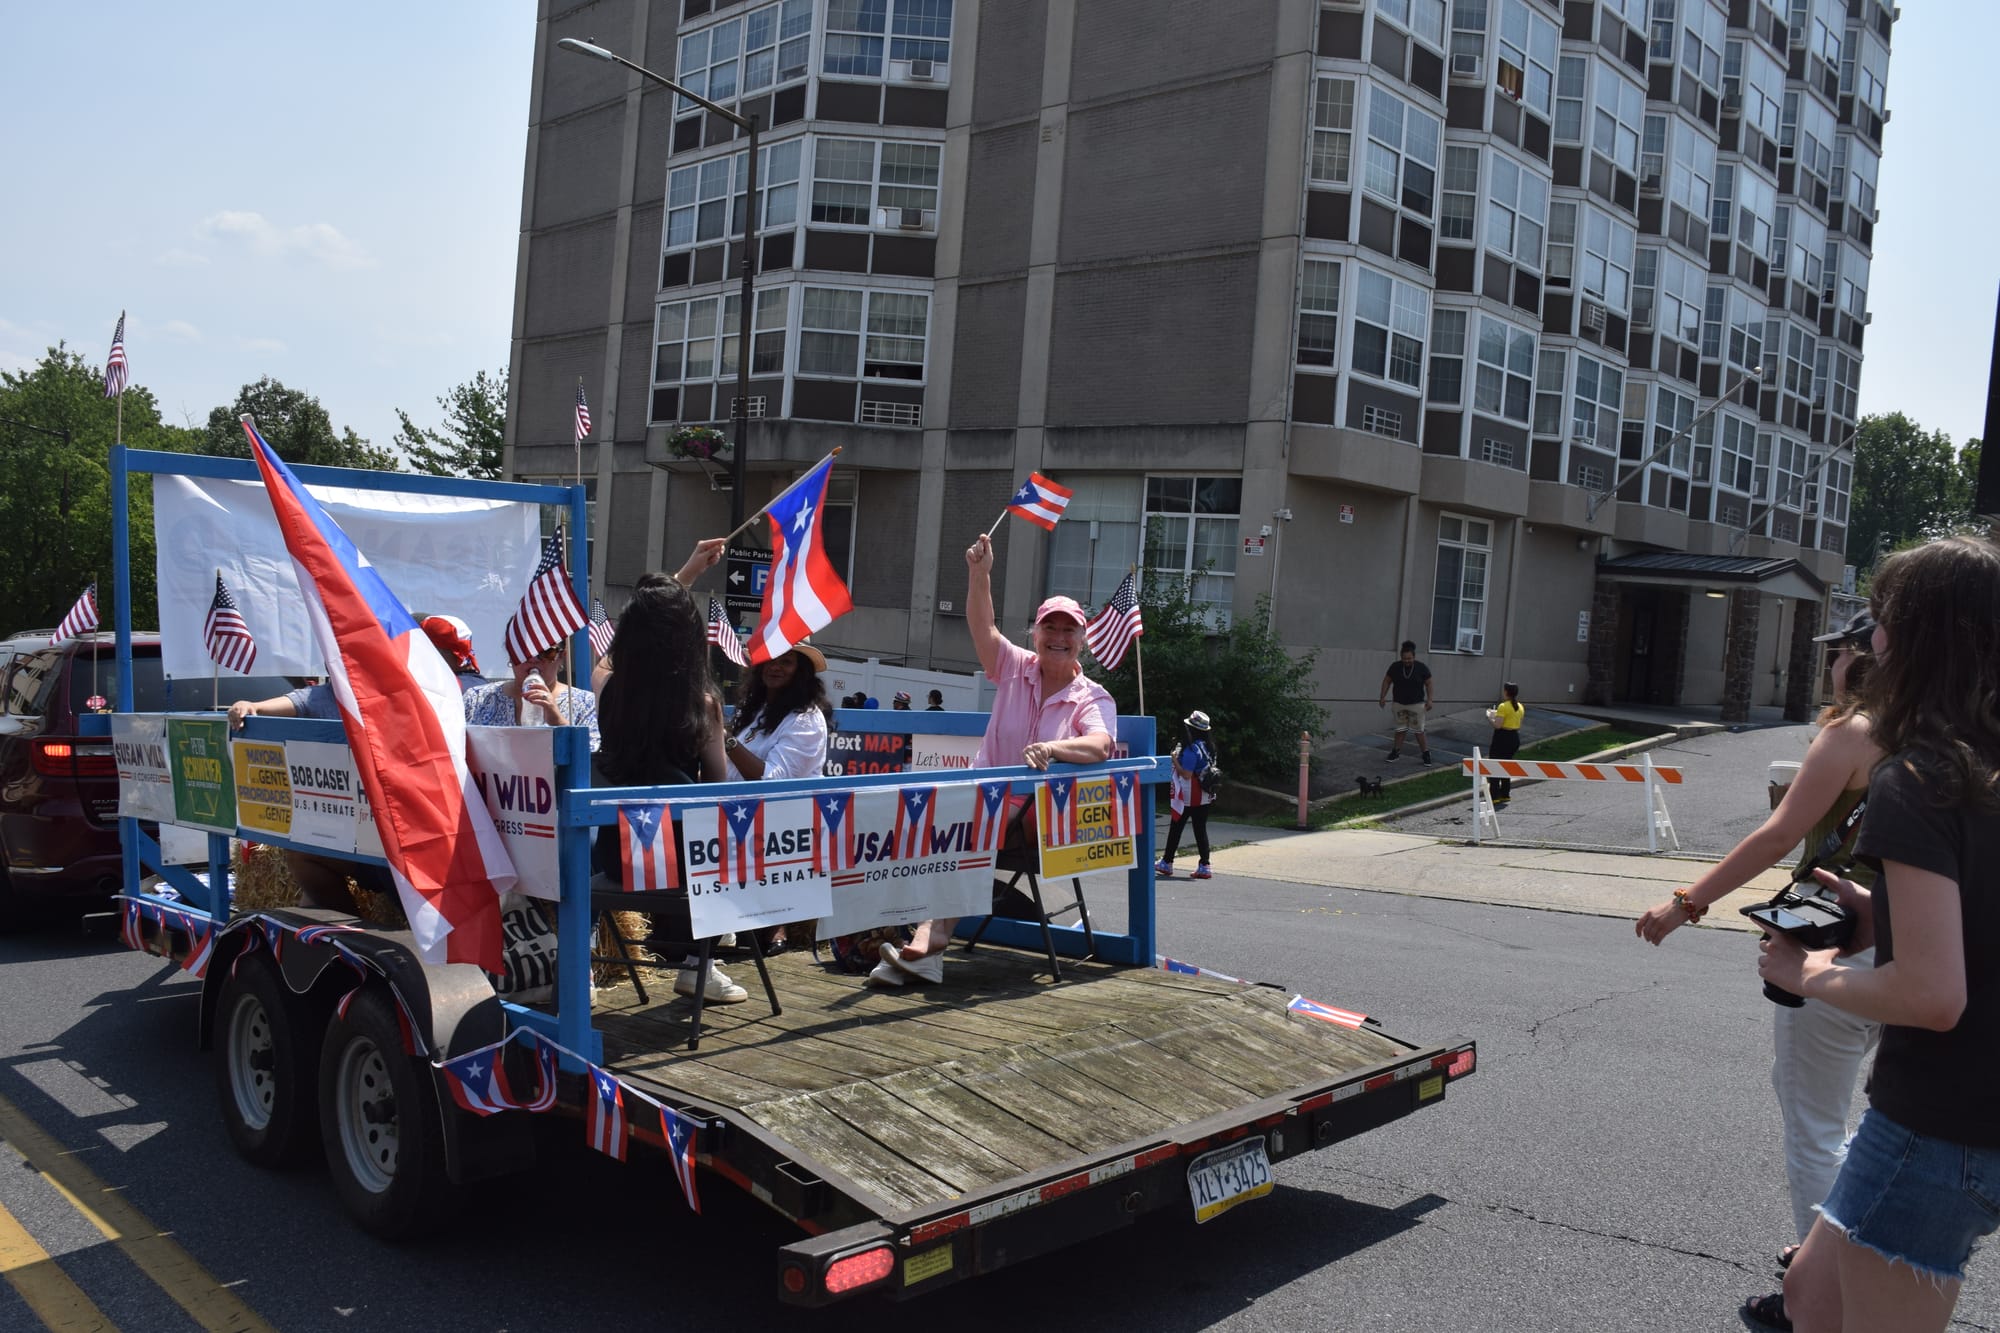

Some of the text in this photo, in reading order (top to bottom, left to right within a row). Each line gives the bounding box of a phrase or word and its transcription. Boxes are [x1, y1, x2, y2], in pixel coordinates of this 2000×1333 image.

[730, 548, 774, 560] Public Parkin
[728, 599, 761, 609] Government
[829, 732, 904, 753] Text MAP
[114, 743, 145, 767] SUSAN
[915, 751, 969, 768] Let's WIN
[826, 760, 844, 776] to
[259, 769, 290, 787] GENTE
[290, 765, 350, 791] BOB CASEY
[238, 785, 291, 805] PRIORIDADES
[493, 772, 552, 815] WILD
[266, 807, 290, 824] GENTE
[294, 799, 311, 811] U.S.
[322, 802, 355, 817] SENATE
[1082, 806, 1112, 824] GEN
[494, 819, 523, 835] GRESS
[1087, 841, 1131, 860] GENTE
[865, 860, 957, 883] FOR CONGRESS
[692, 881, 729, 896] U.S.
